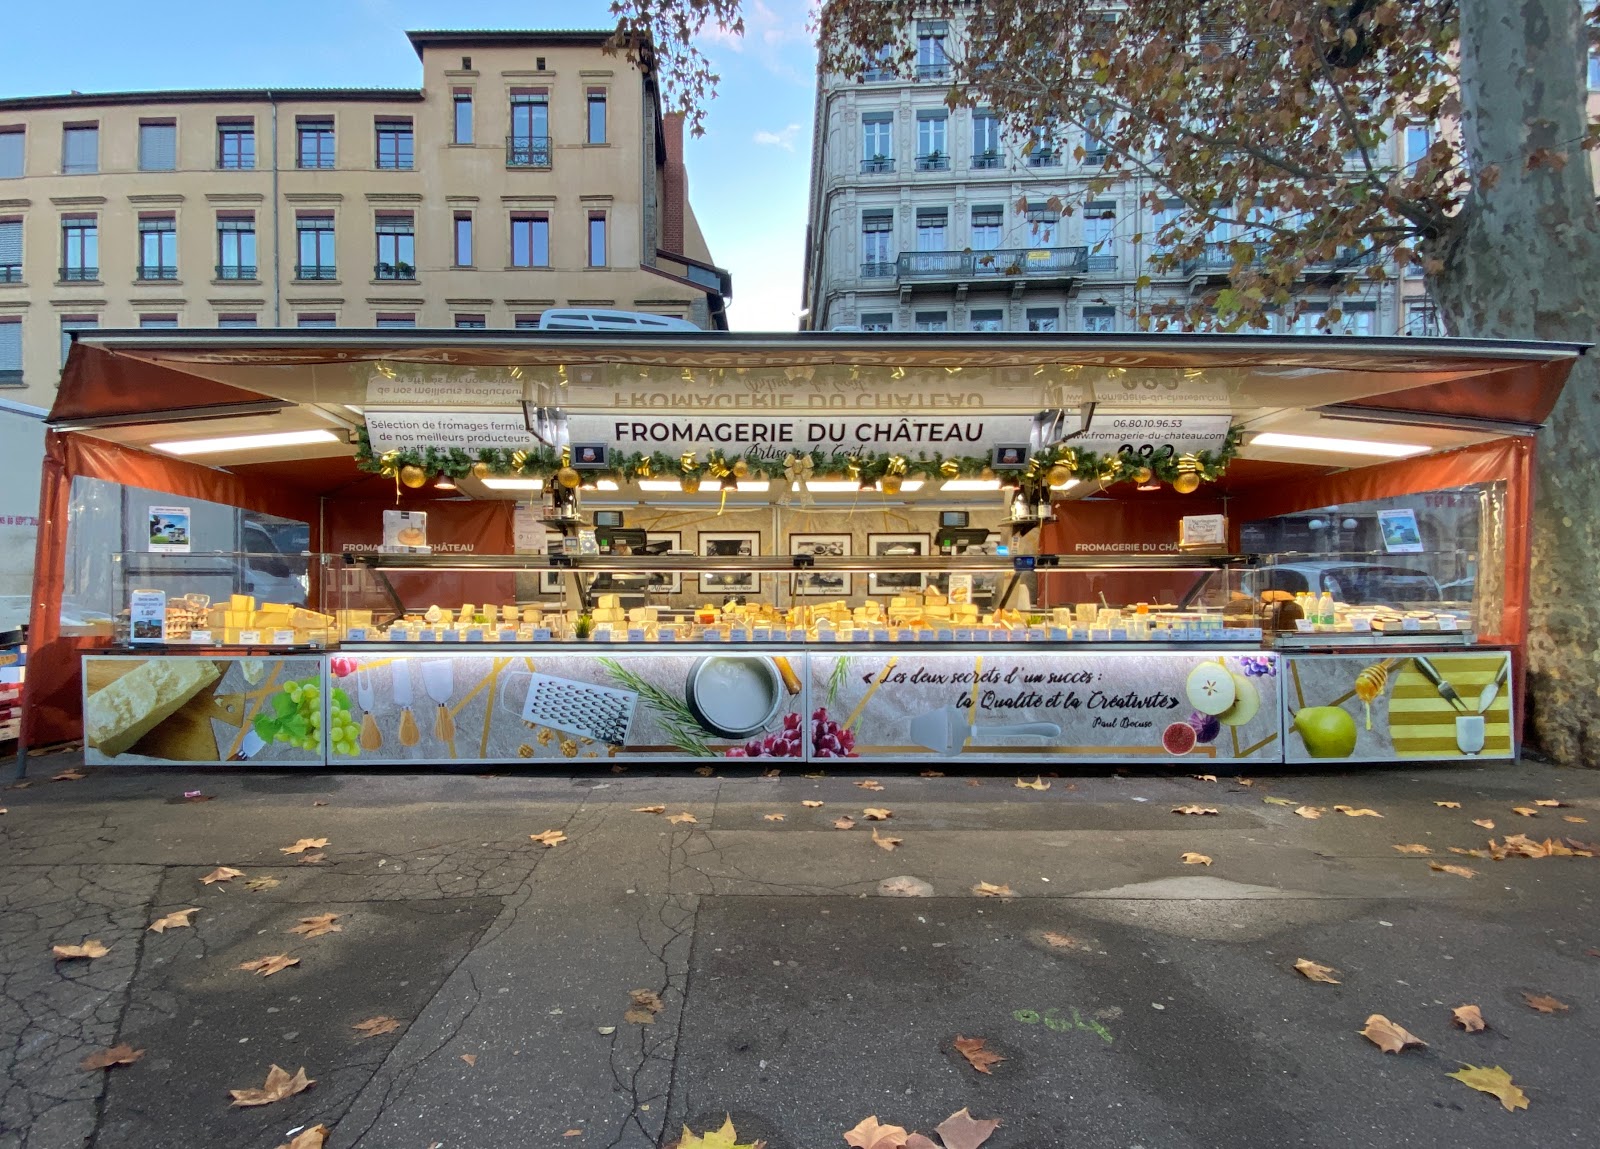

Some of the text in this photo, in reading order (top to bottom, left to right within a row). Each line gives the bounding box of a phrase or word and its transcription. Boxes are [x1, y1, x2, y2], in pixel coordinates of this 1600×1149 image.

[849, 356, 916, 364] DU
[371, 420, 525, 432] Sélection de fromages fermie
[1113, 419, 1182, 428] 06.80.10.96.53
[615, 418, 983, 442] FROMAGERIE DU CHÂTEAU
[379, 433, 393, 441] de
[416, 433, 464, 442] meilleurs
[467, 433, 530, 445] producteurs
[744, 443, 801, 460] Artisas
[428, 542, 474, 551] CHÂTEAU
[1075, 543, 1140, 551] FROMAGERIE
[1142, 543, 1156, 551] DU
[880, 664, 907, 684] Les
[911, 667, 949, 684] deux
[951, 666, 1001, 684] secrets
[956, 691, 974, 709] la
[981, 690, 1043, 710] Qualité
[1045, 691, 1064, 708] et
[1064, 691, 1082, 709] la
[1092, 716, 1153, 729] Paul Bocuse
